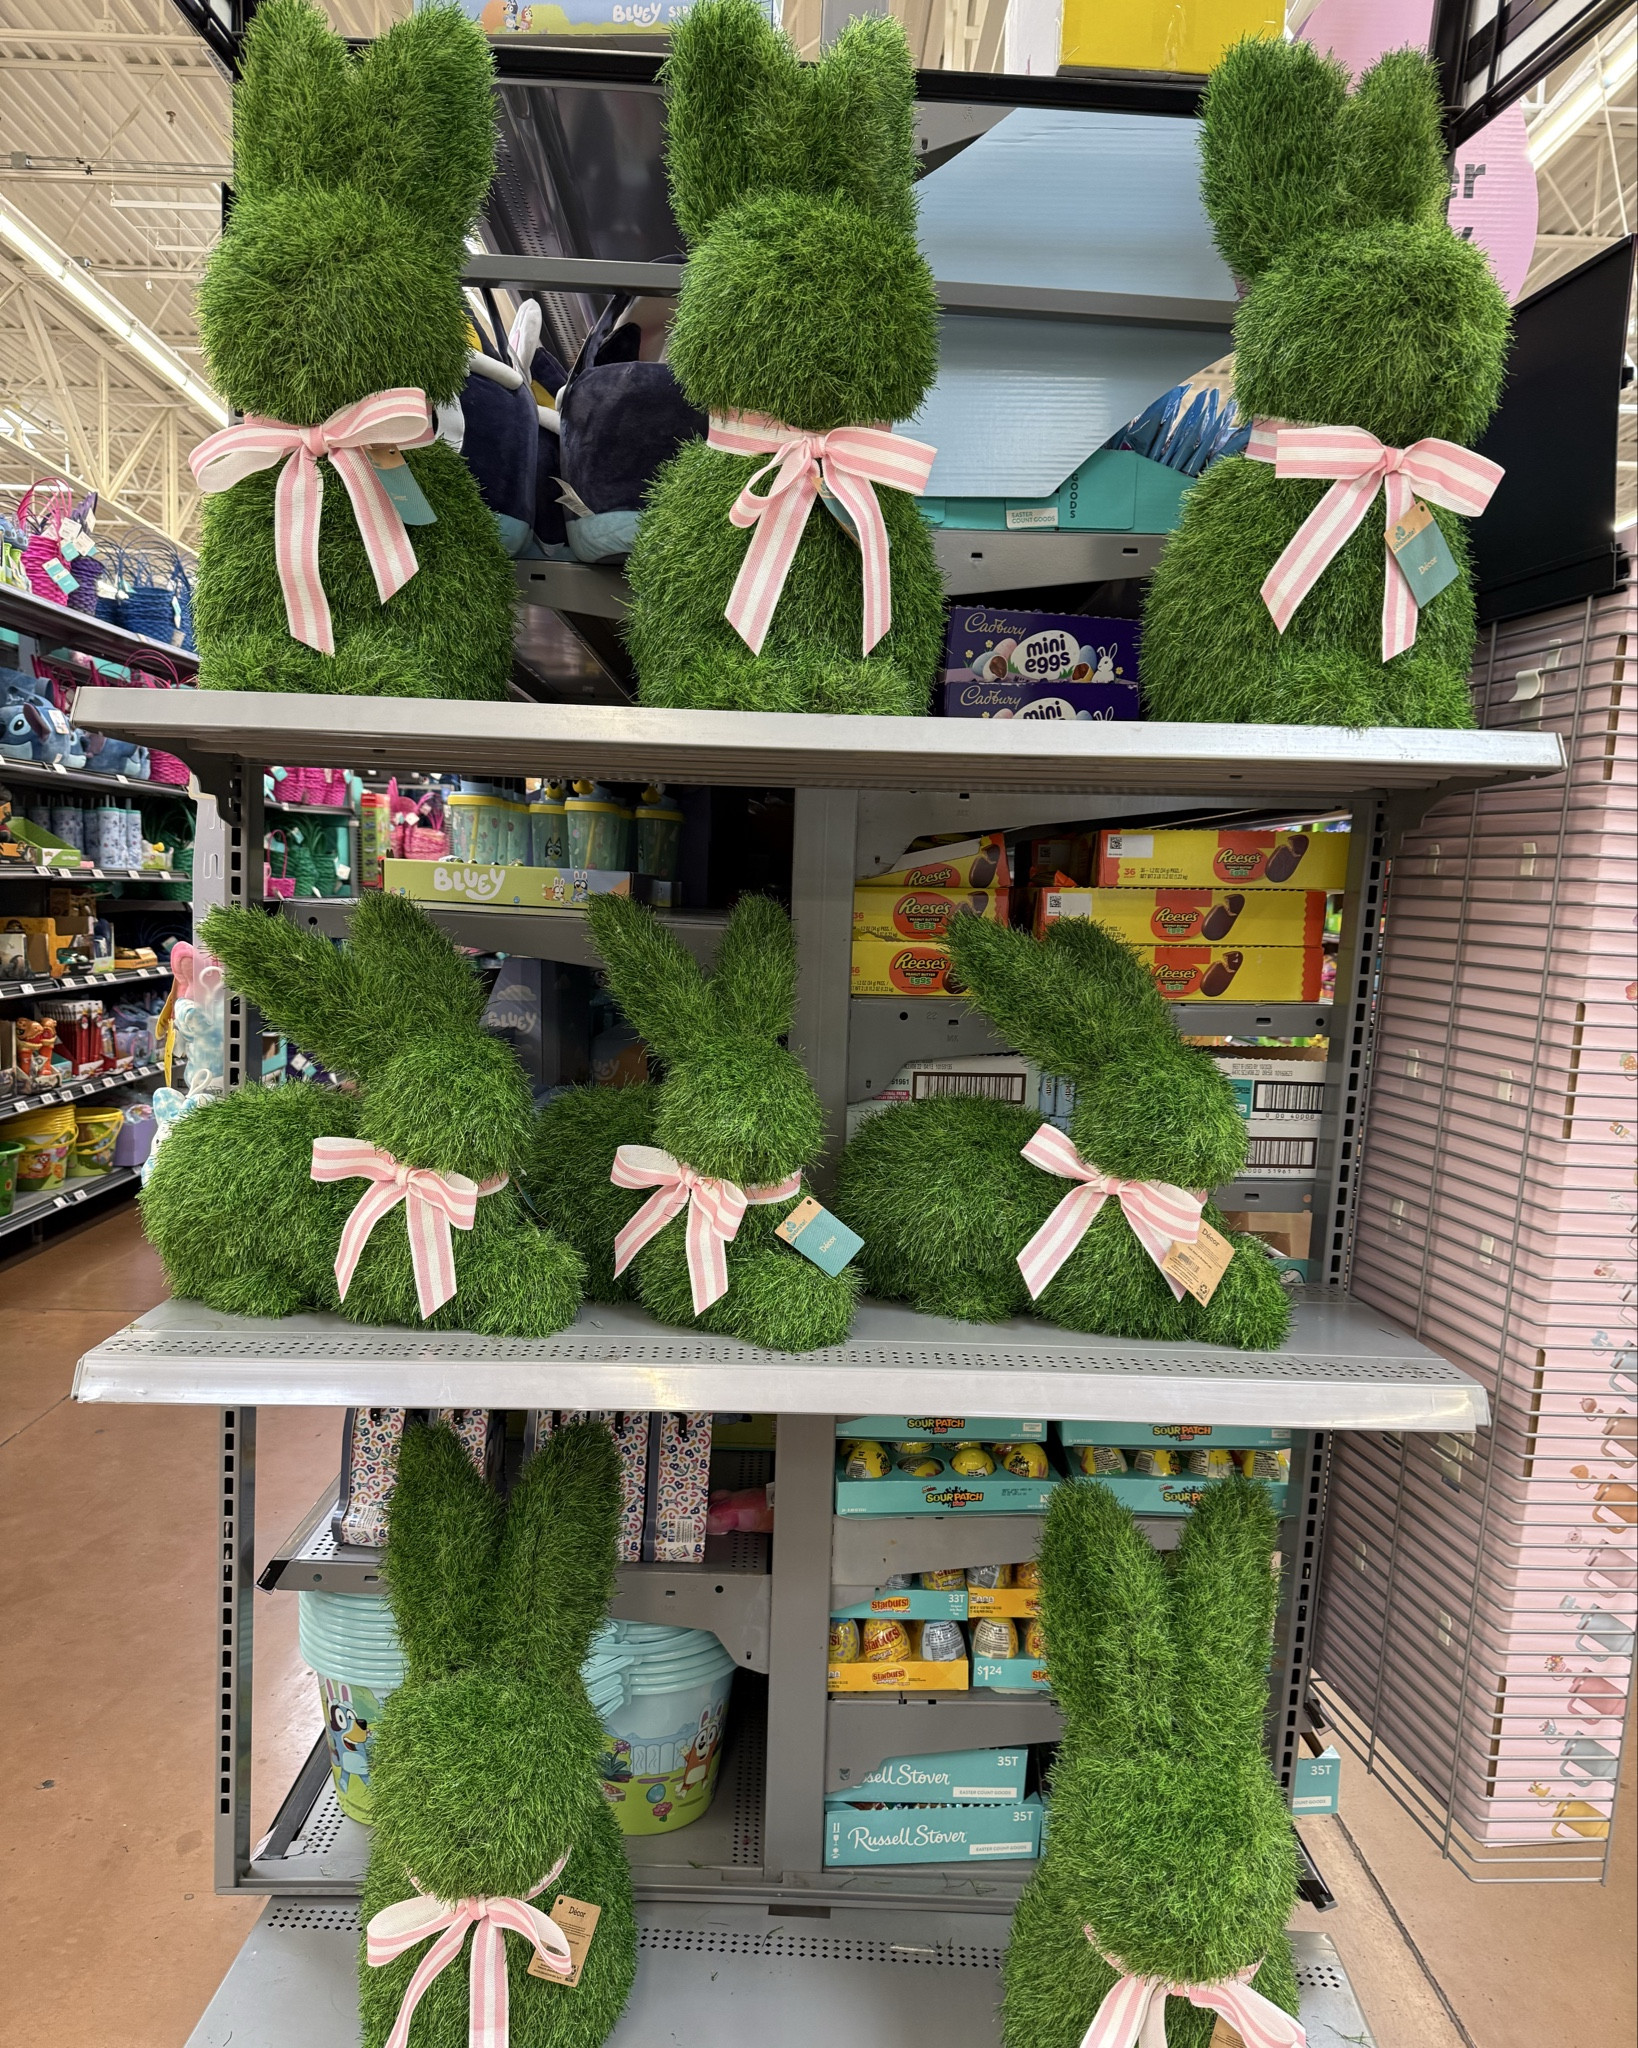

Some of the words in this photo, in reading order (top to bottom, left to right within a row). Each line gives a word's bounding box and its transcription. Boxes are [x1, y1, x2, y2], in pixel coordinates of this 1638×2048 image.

[612, 2, 661, 27] BLUEY
[1069, 473, 1079, 518] GOODS
[965, 612, 1027, 640] Cadbury
[1026, 633, 1066, 658] mini
[1025, 651, 1070, 674] eggs
[960, 685, 1022, 709] Cadbury
[1023, 700, 1062, 719] mini
[1217, 848, 1262, 865] Reese's
[433, 867, 506, 900] BLUEY
[908, 868, 952, 886] Reese's
[898, 897, 951, 915] Reese's
[1155, 907, 1198, 922] Reese's
[913, 922, 936, 930] Eggs
[894, 952, 947, 970] Reese's
[1155, 964, 1197, 979] Reese's
[910, 977, 932, 985] Eggs
[488, 1012, 537, 1034] BLUEY
[818, 1235, 837, 1253] Décor
[1201, 1228, 1220, 1247] Décor
[907, 1418, 934, 1428] SOUR
[935, 1418, 965, 1428] PATCH
[1153, 1426, 1181, 1435] SOUR
[1181, 1426, 1212, 1435] PATCH
[926, 1493, 953, 1502] SOUR
[954, 1492, 984, 1501] PATCH
[1163, 1492, 1191, 1501] SOUR
[871, 1597, 909, 1610] Starburst
[948, 1594, 965, 1603] 33T
[864, 1626, 900, 1652] Starburst
[872, 1669, 905, 1681] Starburst
[997, 1756, 1018, 1766] 35T
[1310, 1765, 1332, 1775] 35T
[896, 1764, 950, 1785] Stover
[1012, 1811, 1034, 1821] 35T
[848, 1826, 913, 1851] Russell
[914, 1825, 967, 1846] Stover
[568, 1906, 587, 1918] Décor
